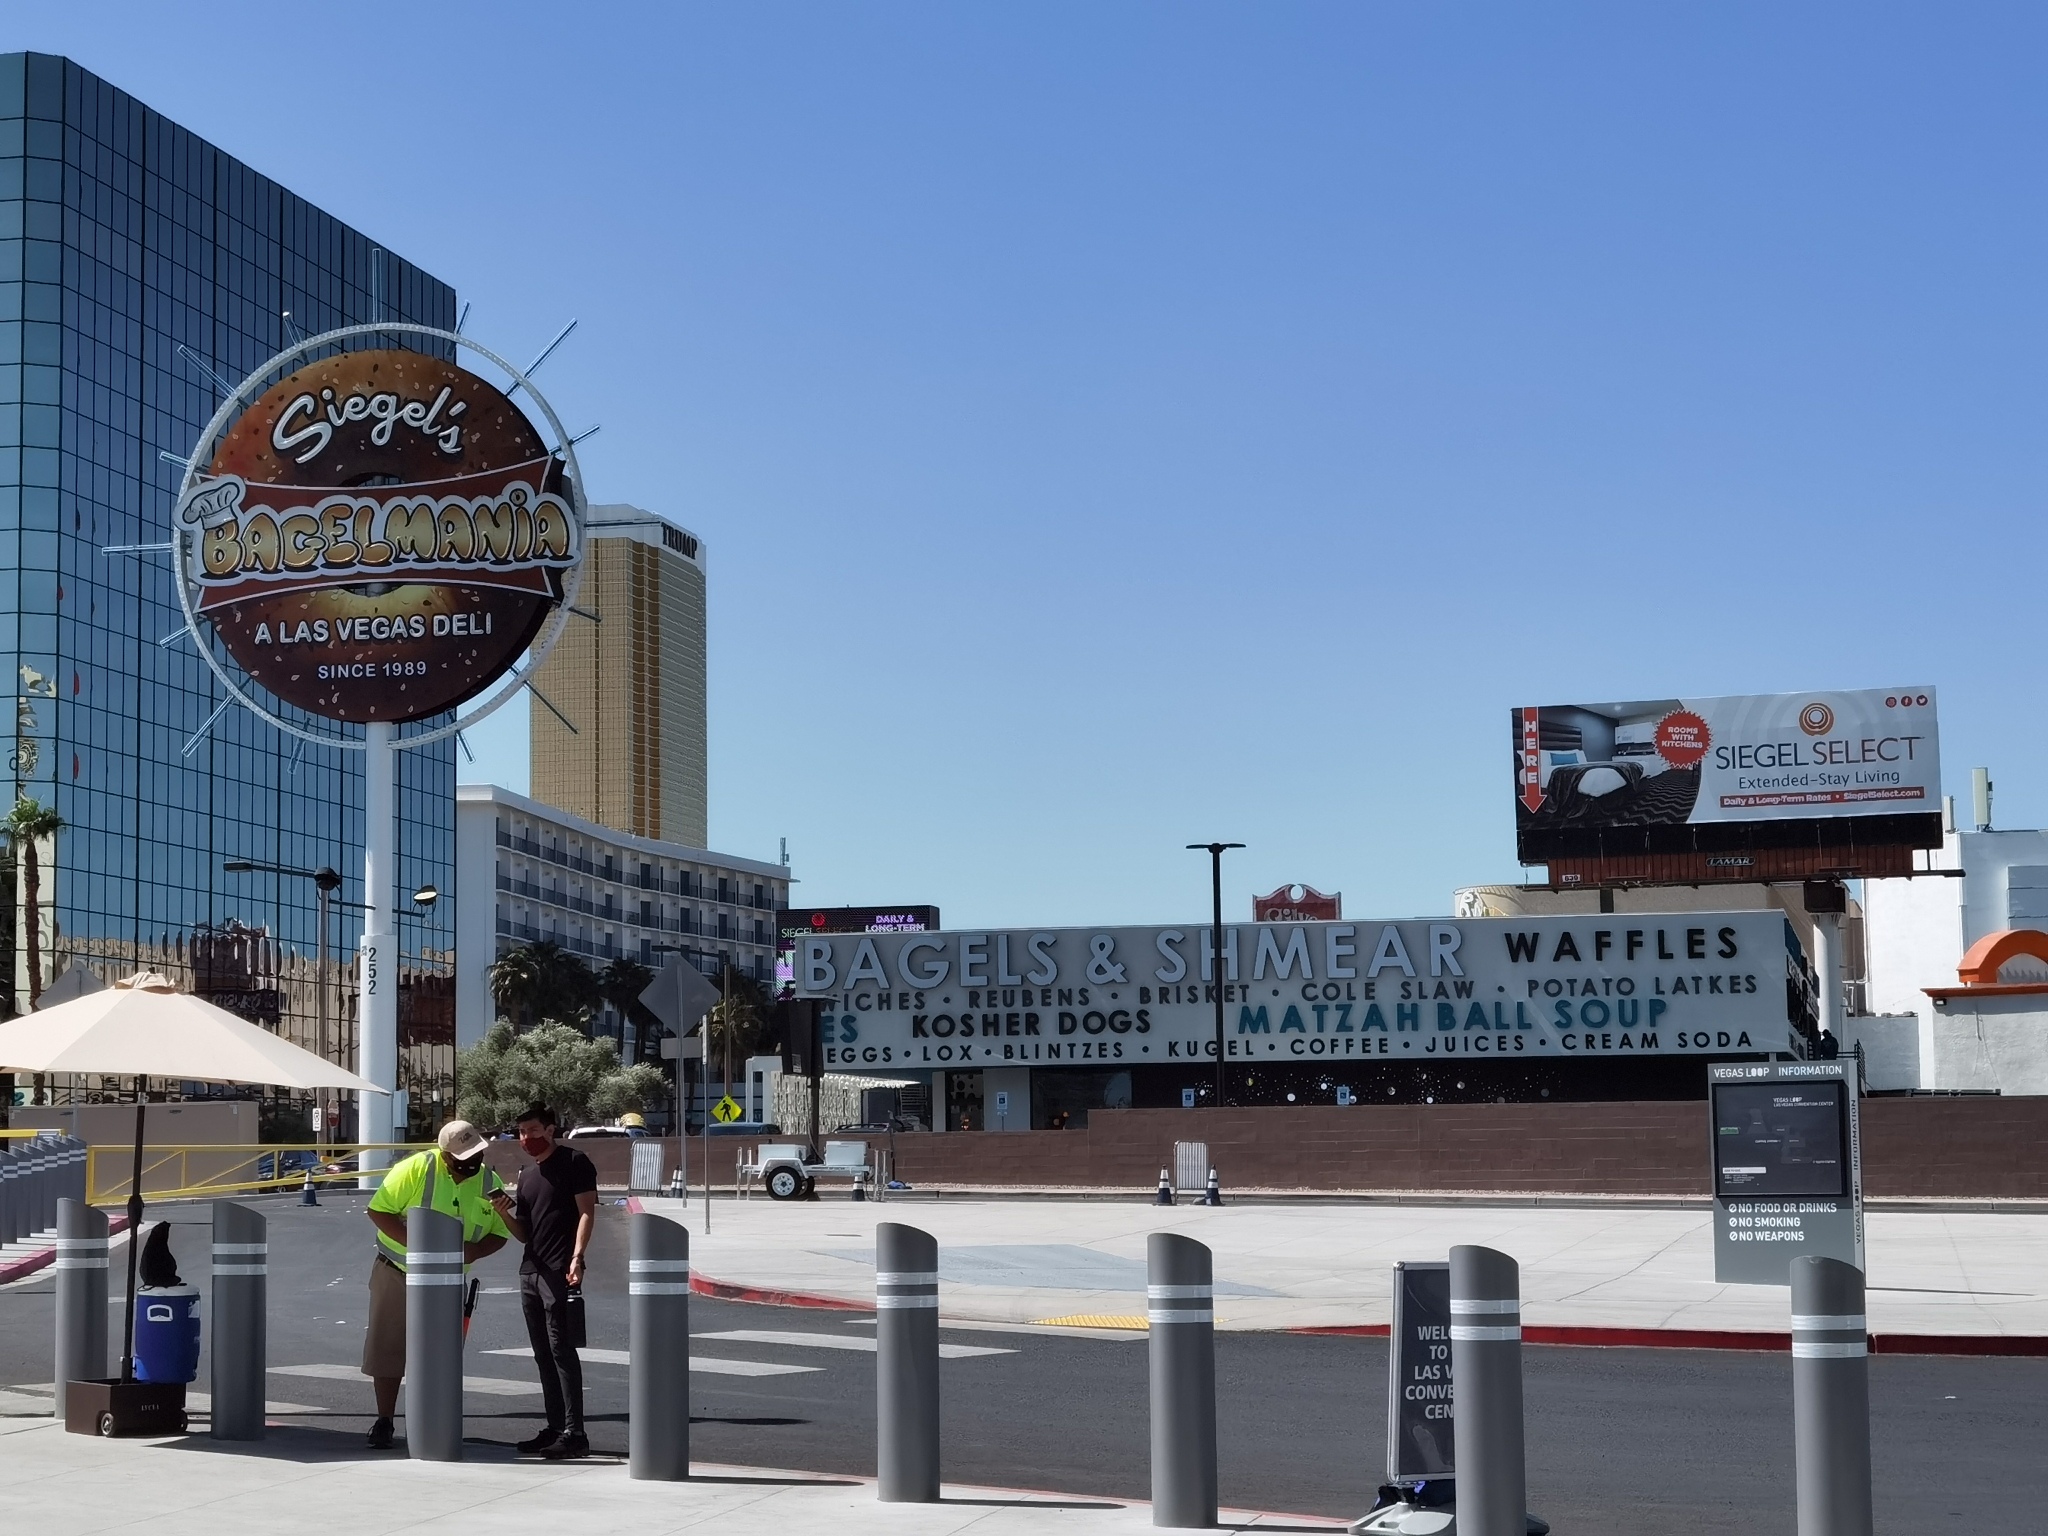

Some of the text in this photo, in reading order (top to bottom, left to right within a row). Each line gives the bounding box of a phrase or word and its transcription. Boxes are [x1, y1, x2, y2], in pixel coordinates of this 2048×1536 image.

[272, 386, 463, 464] Siegel's
[254, 612, 492, 645] A LAS VEGAS DELI
[318, 661, 427, 680] SINCE 1989
[1667, 726, 1698, 734] ROOMS
[1671, 733, 1694, 741] WITH
[1661, 740, 1703, 749] KITCHENS
[1739, 768, 1900, 791] Extended-Stay Living
[1723, 797, 1746, 806] Daily
[875, 914, 914, 924] DAILY &
[865, 923, 925, 932] LONG-TERM
[1504, 926, 1739, 962] WAFFLES
[803, 923, 1464, 991] BAGELS & SHMEAR
[368, 947, 377, 995] 252
[968, 987, 1090, 1009] REUBENS
[1139, 984, 1250, 1005] BRISKET
[1301, 982, 1376, 1001] COLE
[1400, 980, 1474, 1000] SLAW
[1528, 976, 1636, 998] POTATO
[1655, 973, 1758, 996] LATKES
[912, 1012, 1040, 1038] KOSHER
[1058, 1009, 1150, 1036] DOGS
[1238, 1002, 1419, 1034] MATZAH
[1437, 1000, 1532, 1032] BALL
[1554, 998, 1668, 1030] SOUP
[827, 1030, 1752, 1063] EGGS LOX BLINTZES KUGEL COFFEE JUICES CREAM SODA
[1714, 1065, 1842, 1078] VEGAS LOOP INFORMATION
[1850, 1099, 1859, 1170] INFORMATION
[1739, 1203, 1837, 1213] NO FOOD OR DRINKS
[1739, 1217, 1801, 1227] NO SMOKING
[1739, 1231, 1804, 1241] NO WEAPONS
[1429, 1345, 1448, 1360] TO
[1415, 1365, 1440, 1380] LAS
